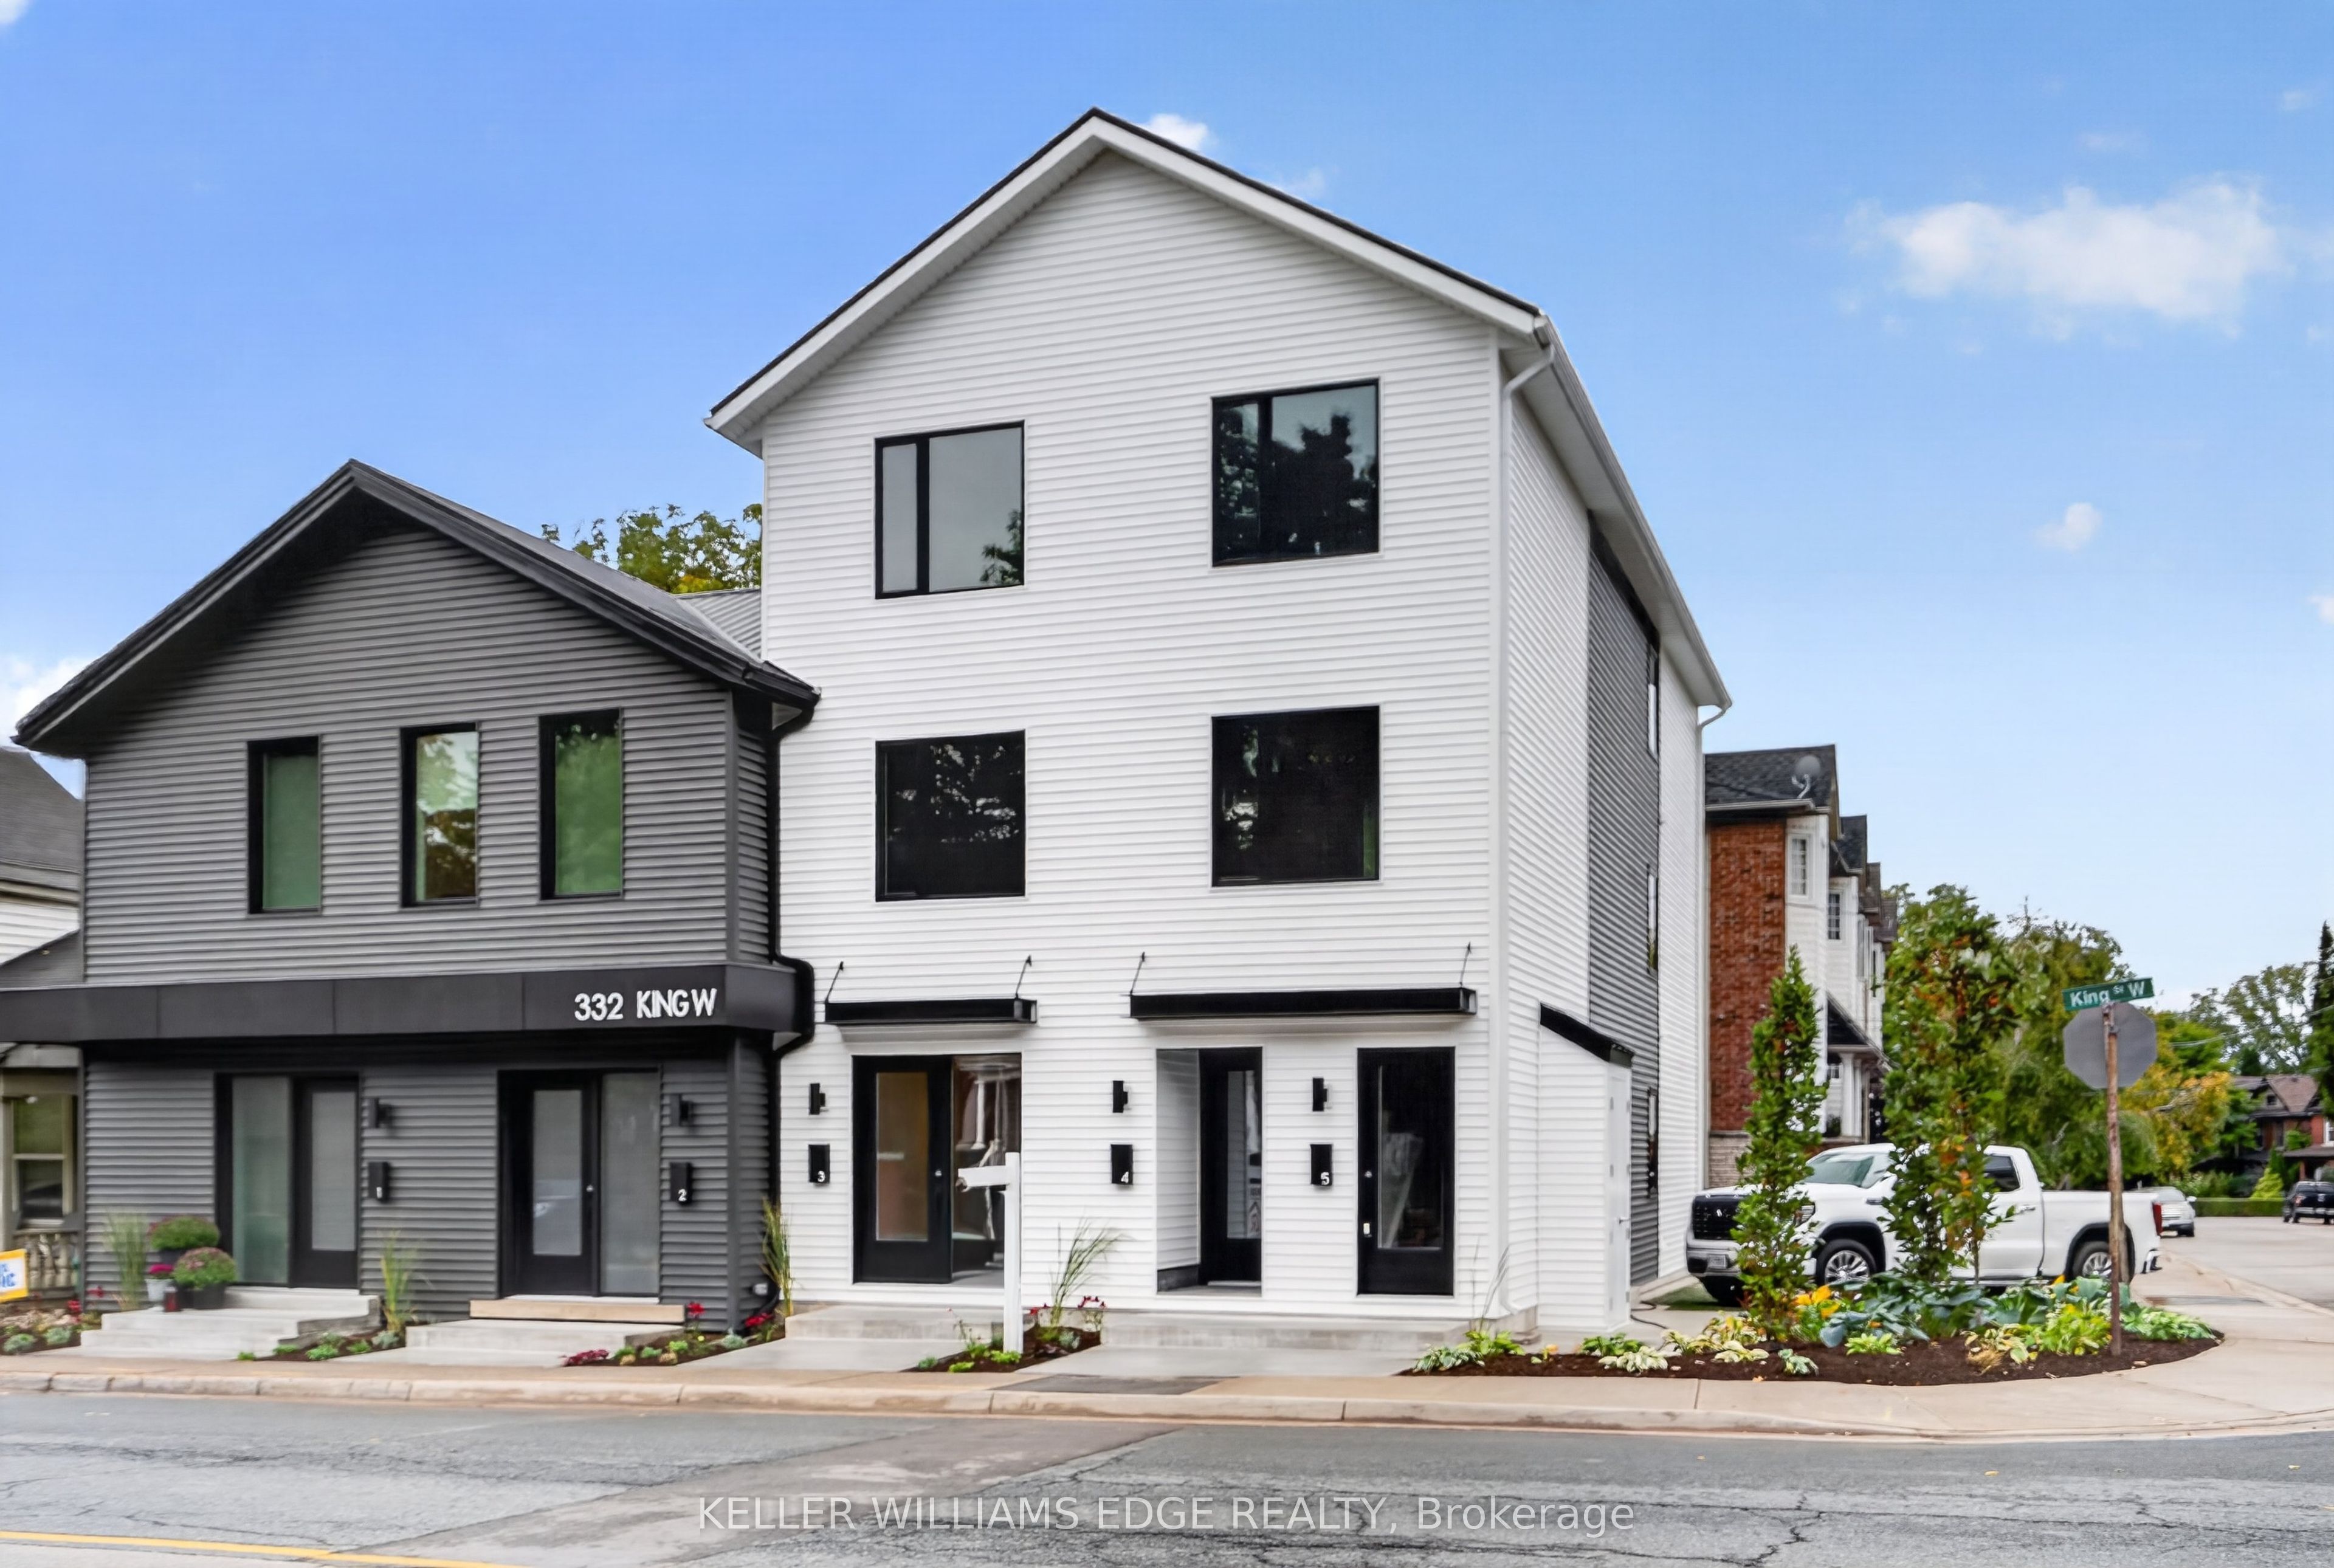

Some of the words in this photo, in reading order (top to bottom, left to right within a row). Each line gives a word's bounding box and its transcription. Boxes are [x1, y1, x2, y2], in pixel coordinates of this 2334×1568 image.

[2070, 989, 2110, 1007] King
[2128, 980, 2145, 998] W
[574, 992, 624, 1021] 332
[818, 1171, 825, 1183] 3
[1320, 1172, 1330, 1185] 5
[678, 1189, 687, 1202] 2
